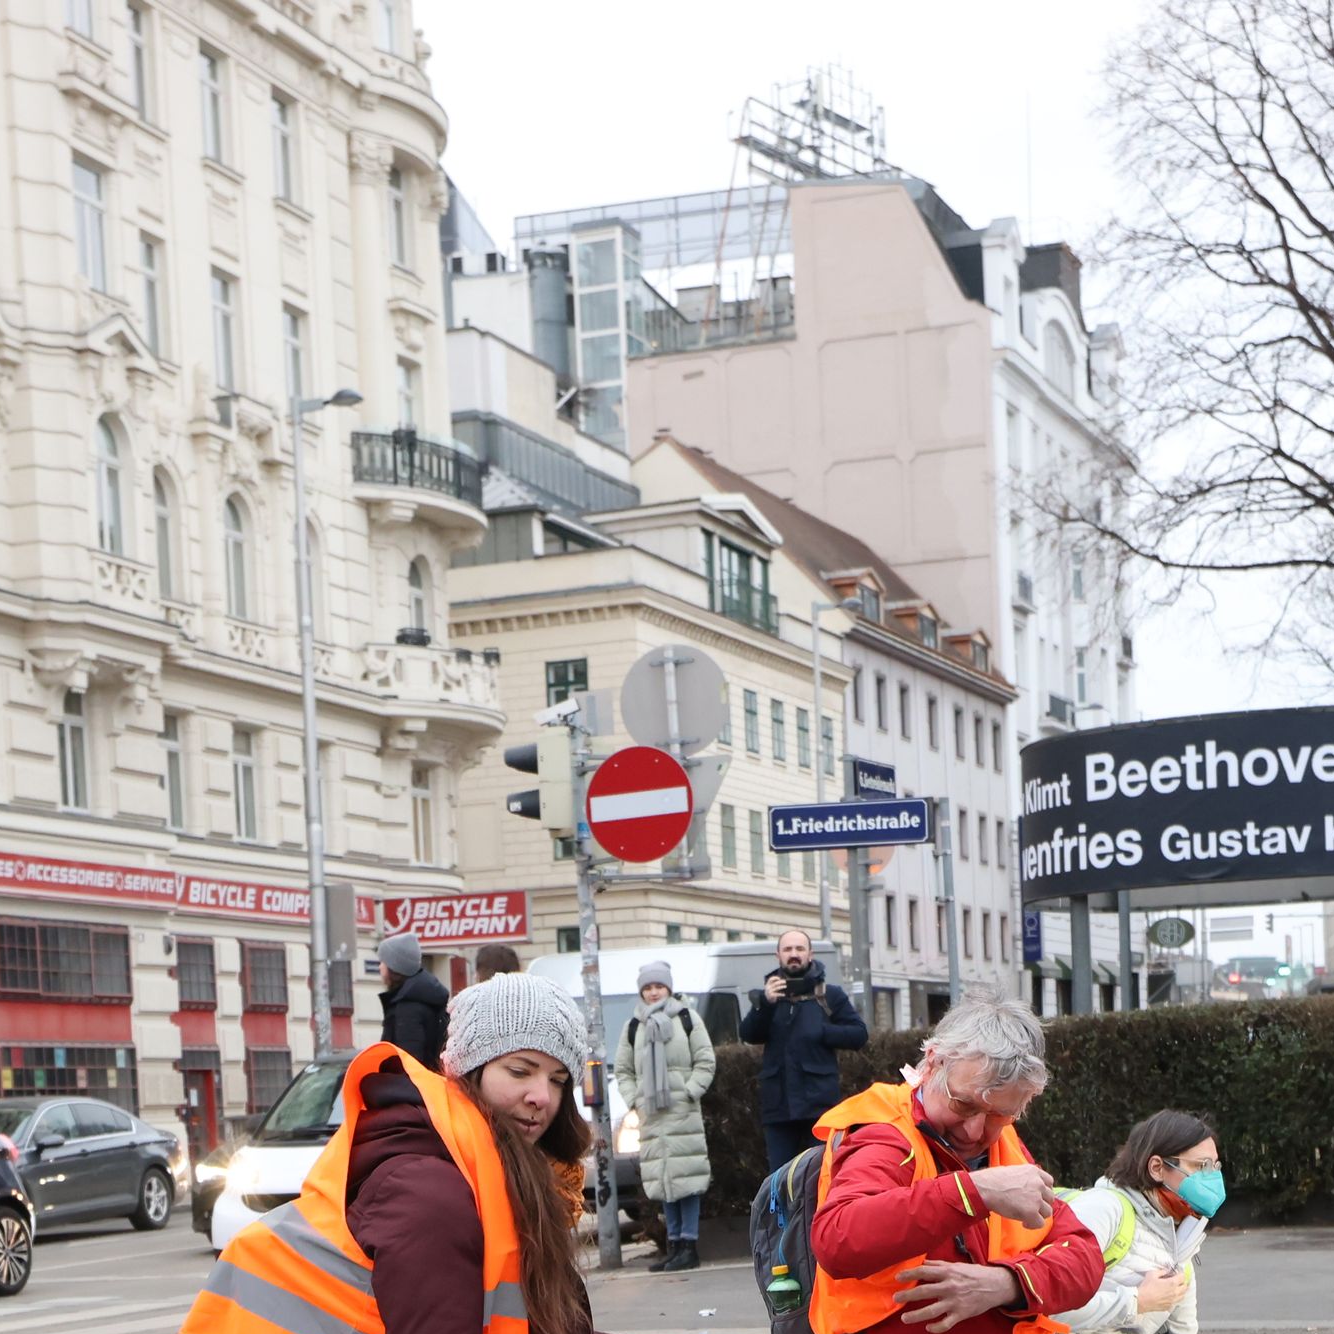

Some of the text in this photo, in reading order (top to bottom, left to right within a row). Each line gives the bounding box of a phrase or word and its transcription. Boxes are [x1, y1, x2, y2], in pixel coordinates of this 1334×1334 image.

[1025, 773, 1071, 815] Klimt
[1160, 822, 1311, 862] Gustav
[26, 863, 114, 889] ACCESSORIES
[124, 874, 174, 895] SERVICE
[189, 881, 255, 909] BICYCLE
[413, 896, 508, 919] BICYCLE
[410, 915, 522, 938] COMPANY
